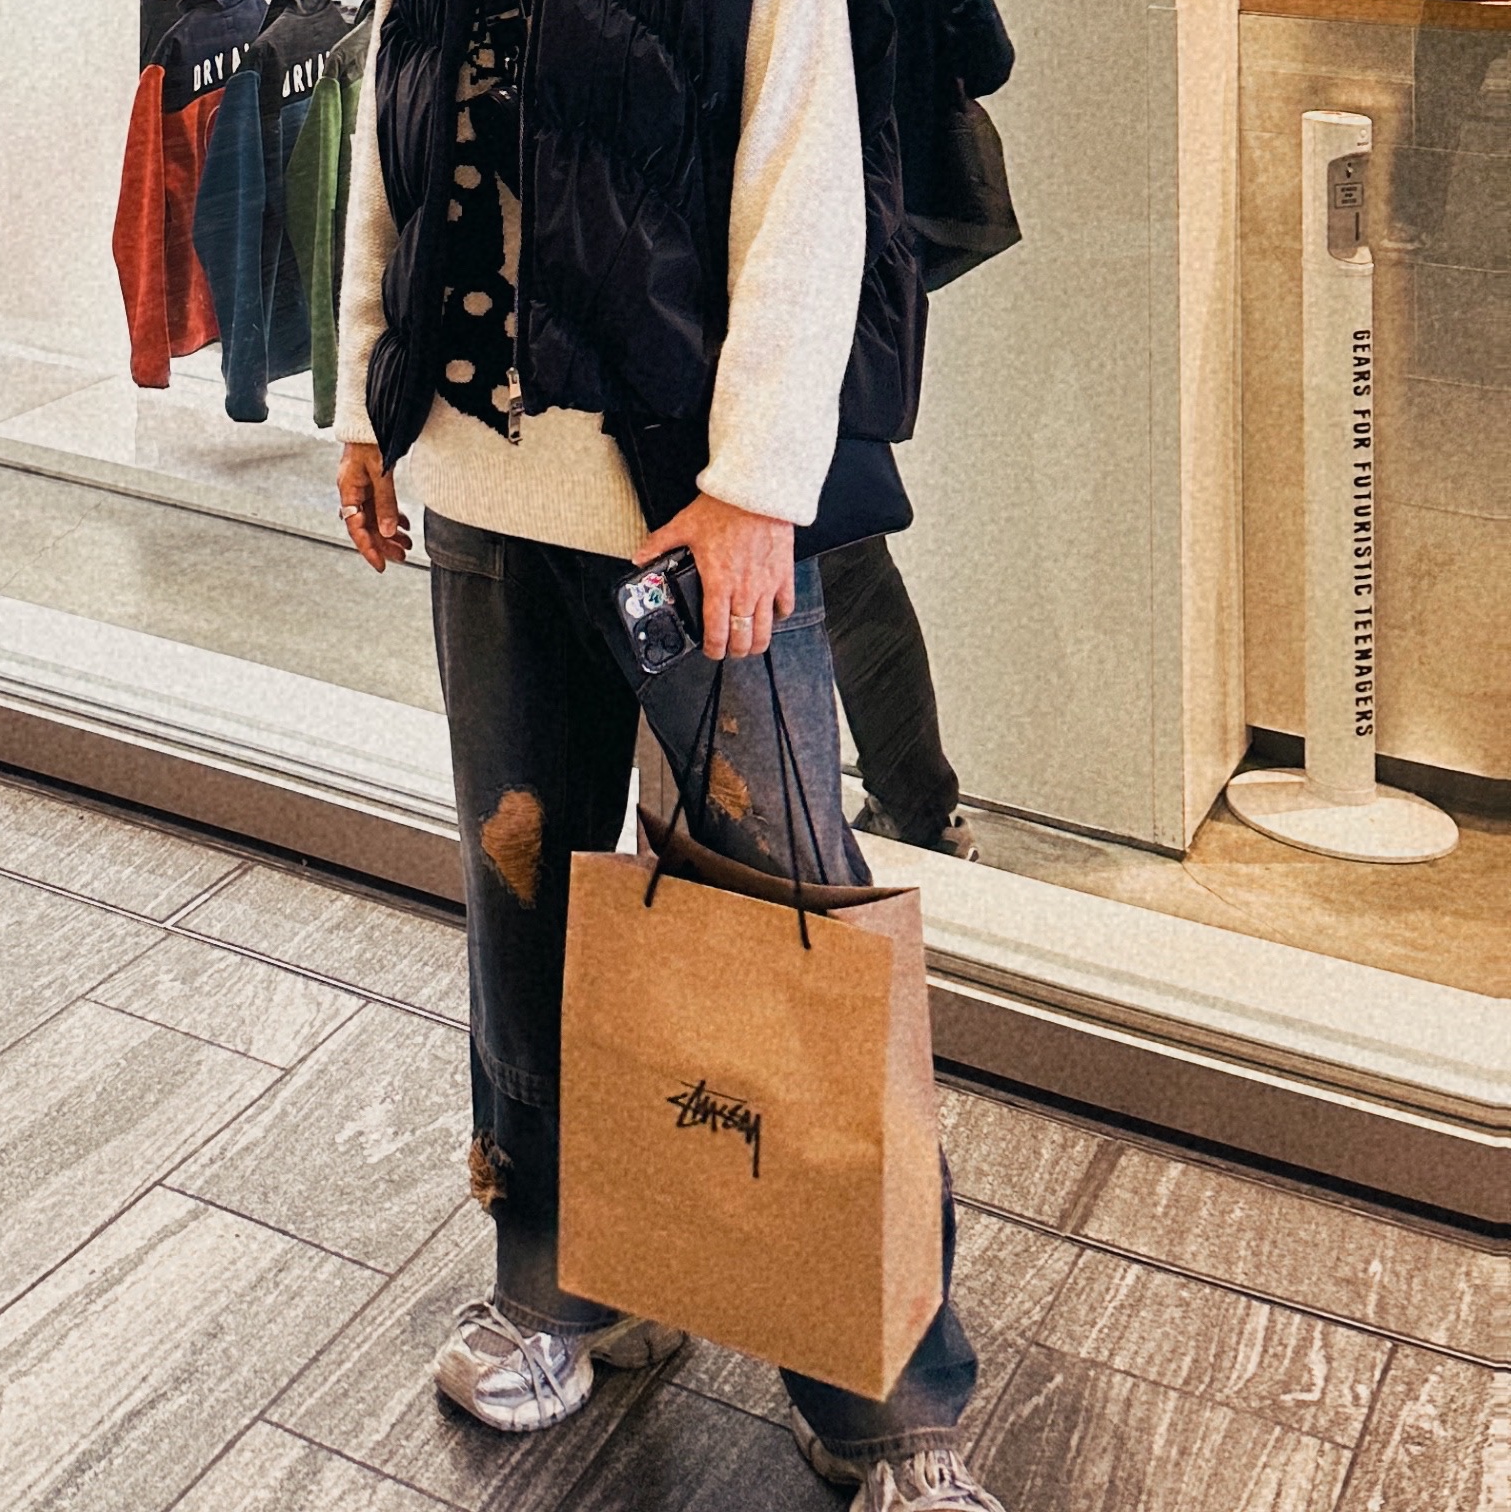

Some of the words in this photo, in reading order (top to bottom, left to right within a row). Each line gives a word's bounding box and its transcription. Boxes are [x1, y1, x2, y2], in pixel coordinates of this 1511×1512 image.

[193, 52, 224, 92] DRY
[1352, 329, 1372, 397] GEARS
[1352, 408, 1372, 450] FOR
[1353, 461, 1373, 597] FUTURISTIC
[1354, 604, 1374, 738] TEENAGERS
